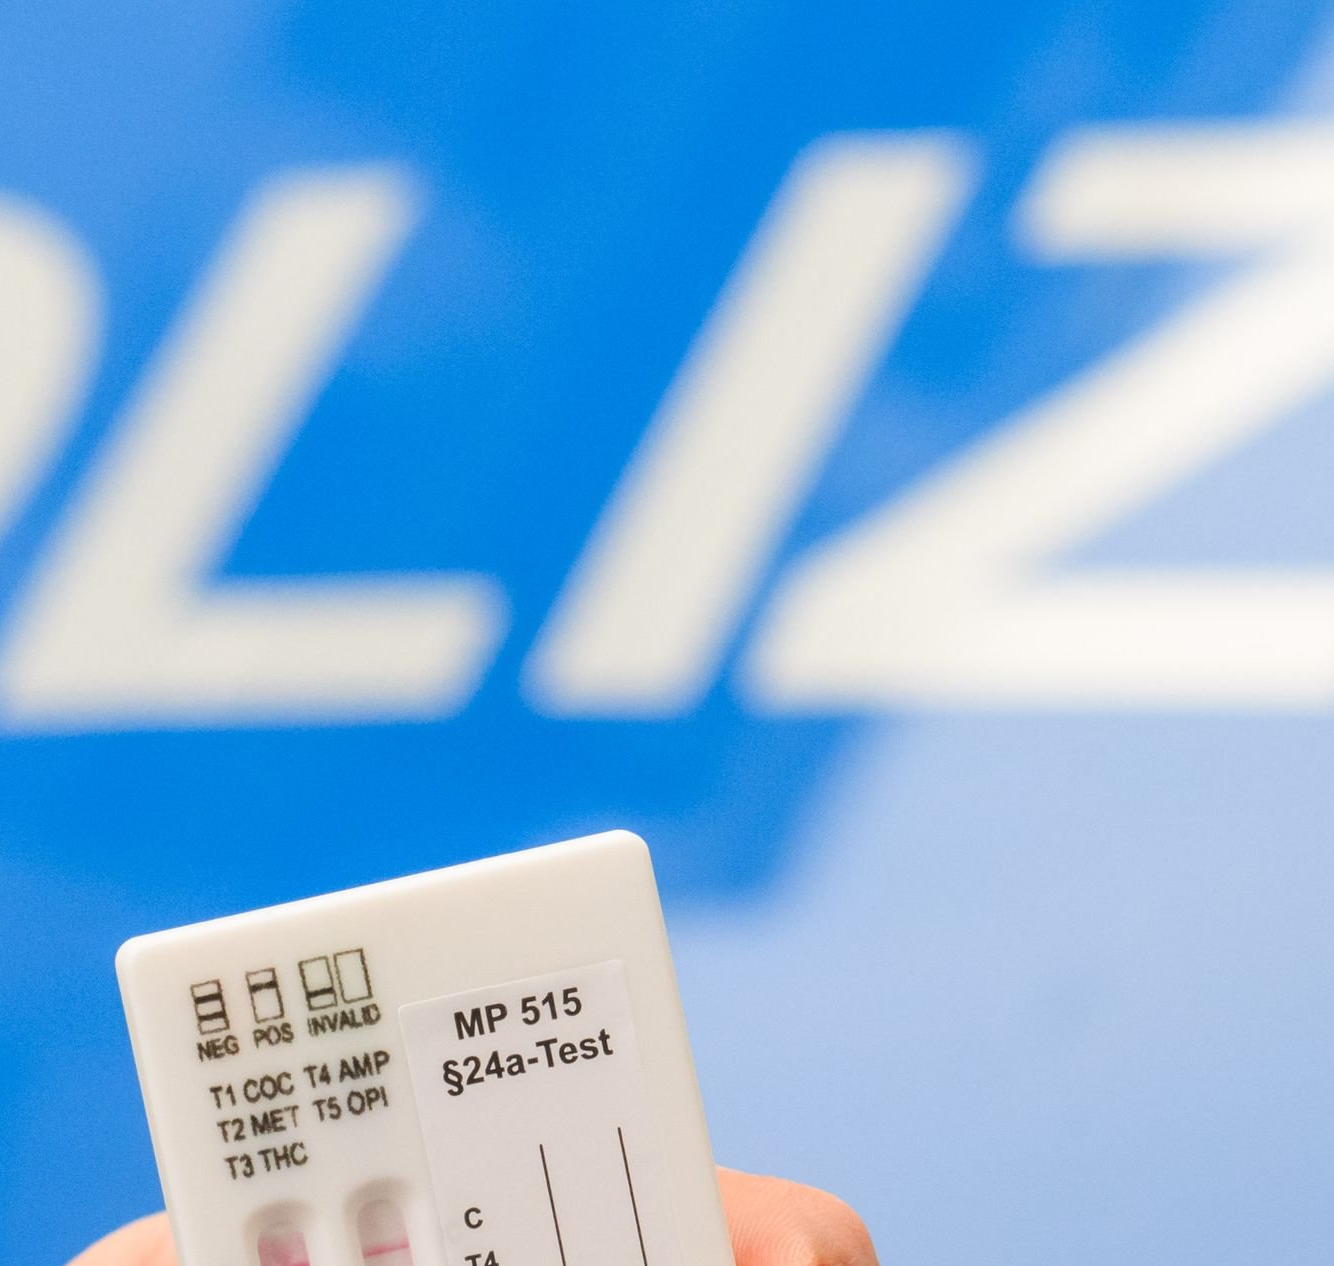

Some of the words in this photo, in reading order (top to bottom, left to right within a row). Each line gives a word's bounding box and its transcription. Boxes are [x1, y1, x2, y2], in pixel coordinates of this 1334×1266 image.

[307, 1004, 382, 1036] INVALID
[453, 1003, 507, 1040] MP
[521, 986, 582, 1025] 515
[197, 1035, 240, 1061] NEG
[253, 1023, 295, 1048] POS
[209, 1084, 237, 1109] T1
[243, 1071, 295, 1103] COC
[303, 1063, 331, 1088] T4
[339, 1050, 390, 1082] AMP
[442, 1028, 614, 1097] §24a-Test
[217, 1118, 246, 1142] T2
[250, 1105, 299, 1136] MET
[313, 1097, 342, 1122] T5
[347, 1086, 389, 1115] OPI
[225, 1154, 255, 1179] T3
[257, 1142, 309, 1172] THC
[463, 1207, 483, 1229] C
